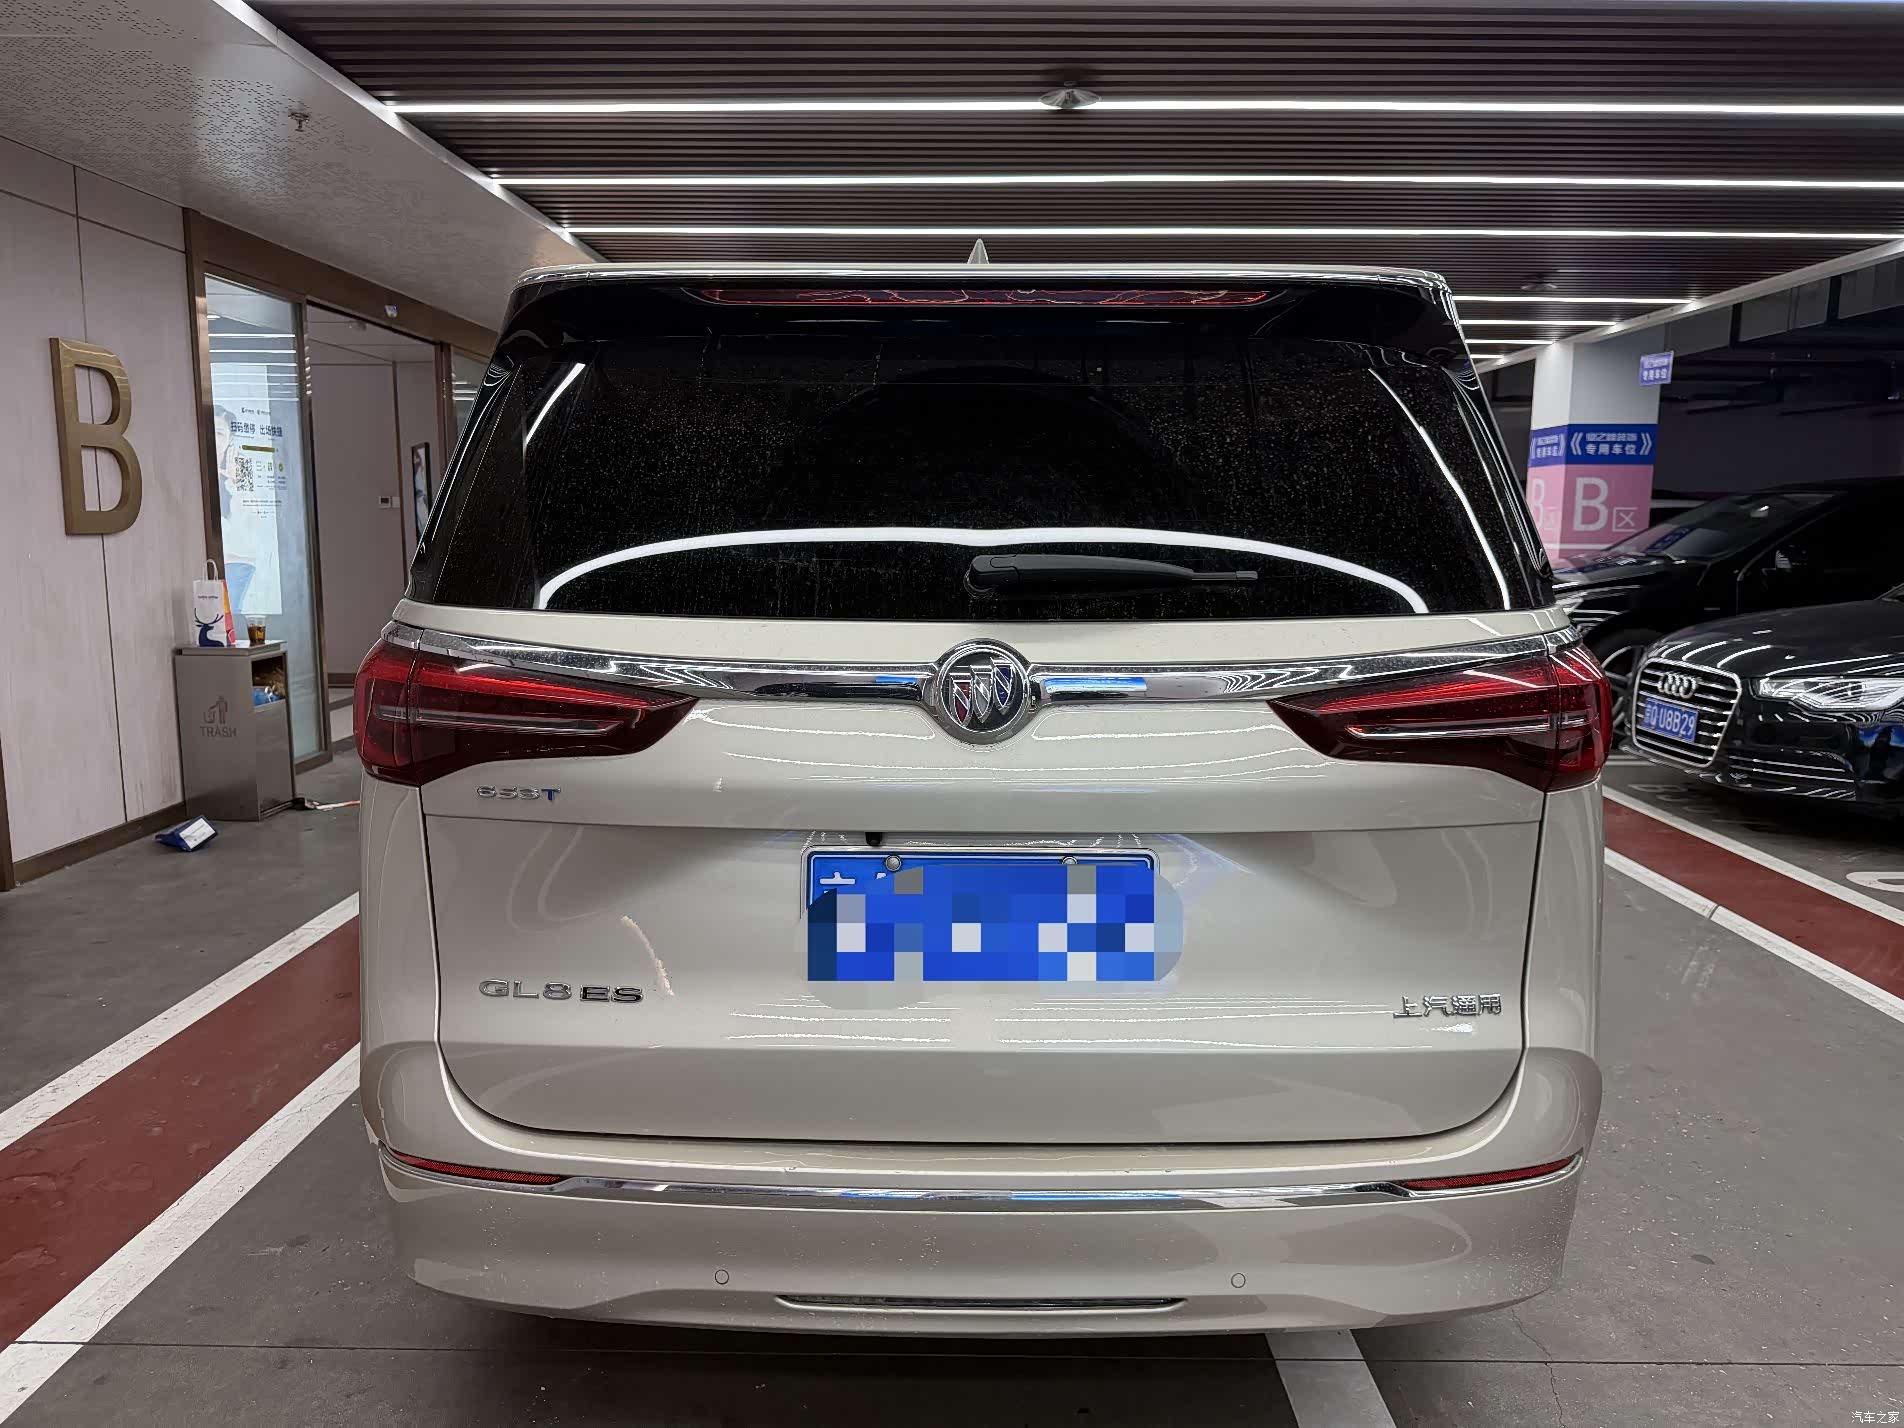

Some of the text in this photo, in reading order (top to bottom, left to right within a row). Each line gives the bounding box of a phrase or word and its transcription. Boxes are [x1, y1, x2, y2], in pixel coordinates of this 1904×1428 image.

[48, 337, 143, 536] B
[1585, 443, 1637, 456] 专用车位
[199, 726, 237, 738] TRASH
[479, 979, 644, 1003] GL8 ES
[1393, 993, 1501, 1018] 上汽通用
